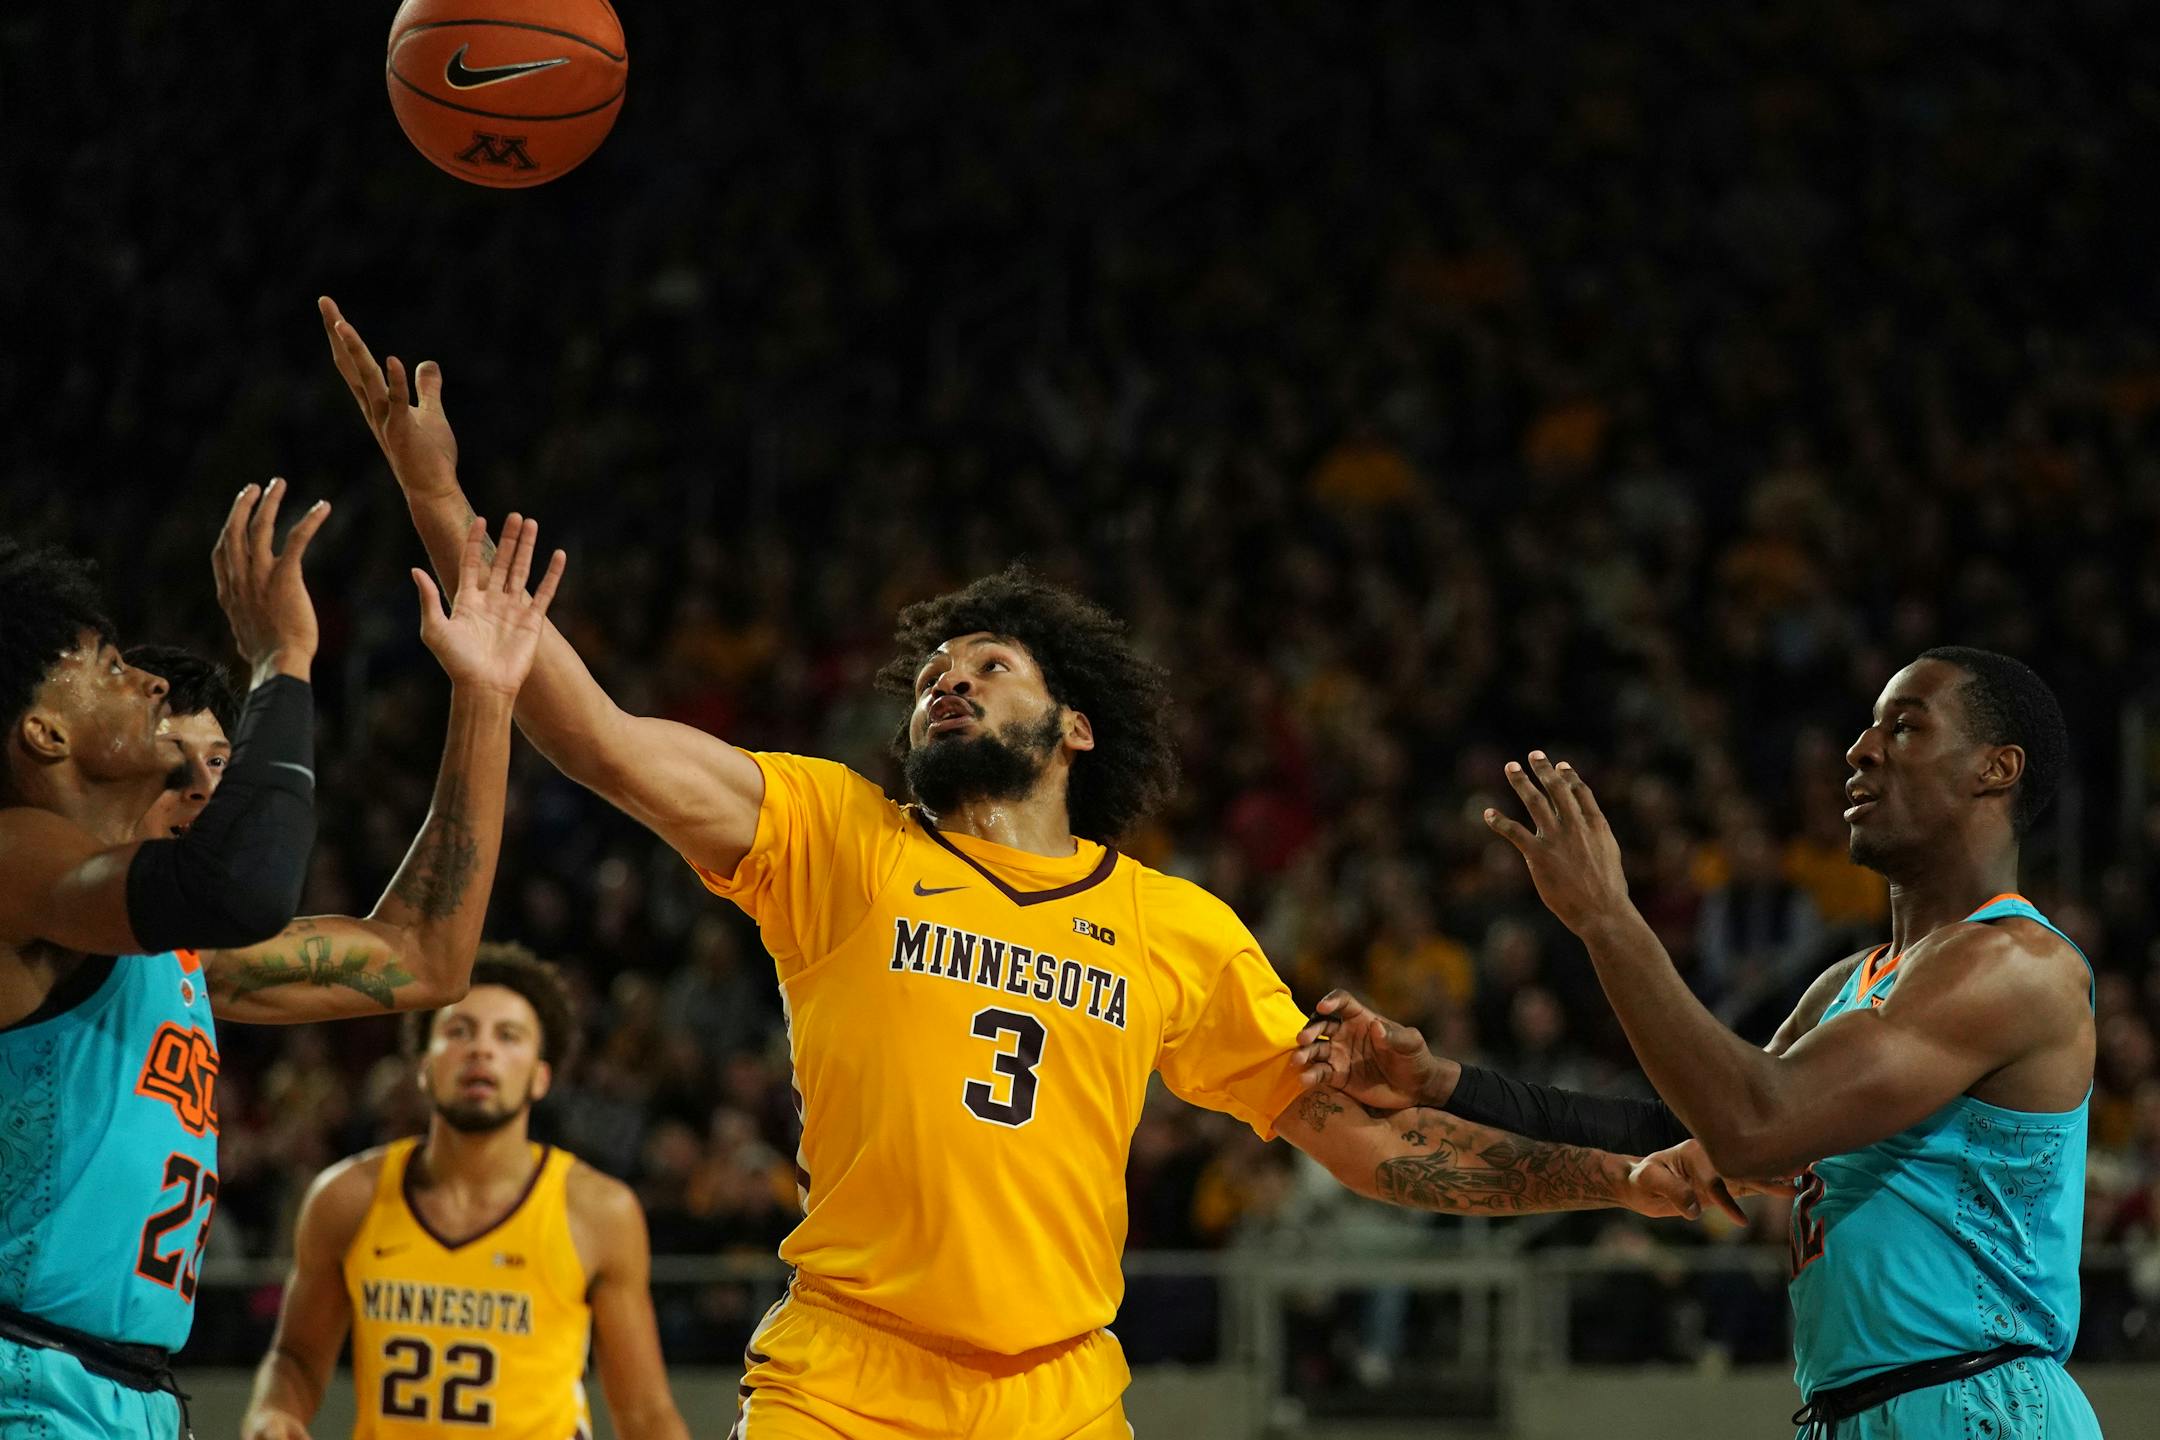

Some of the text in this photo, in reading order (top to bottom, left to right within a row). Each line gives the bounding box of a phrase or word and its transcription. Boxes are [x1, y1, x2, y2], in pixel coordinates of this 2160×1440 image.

[889, 916, 1128, 1031] MINNESOTA
[962, 1004, 1048, 1129] 3
[361, 1279, 533, 1336] MINNESOTA
[381, 1333, 498, 1428] 22
